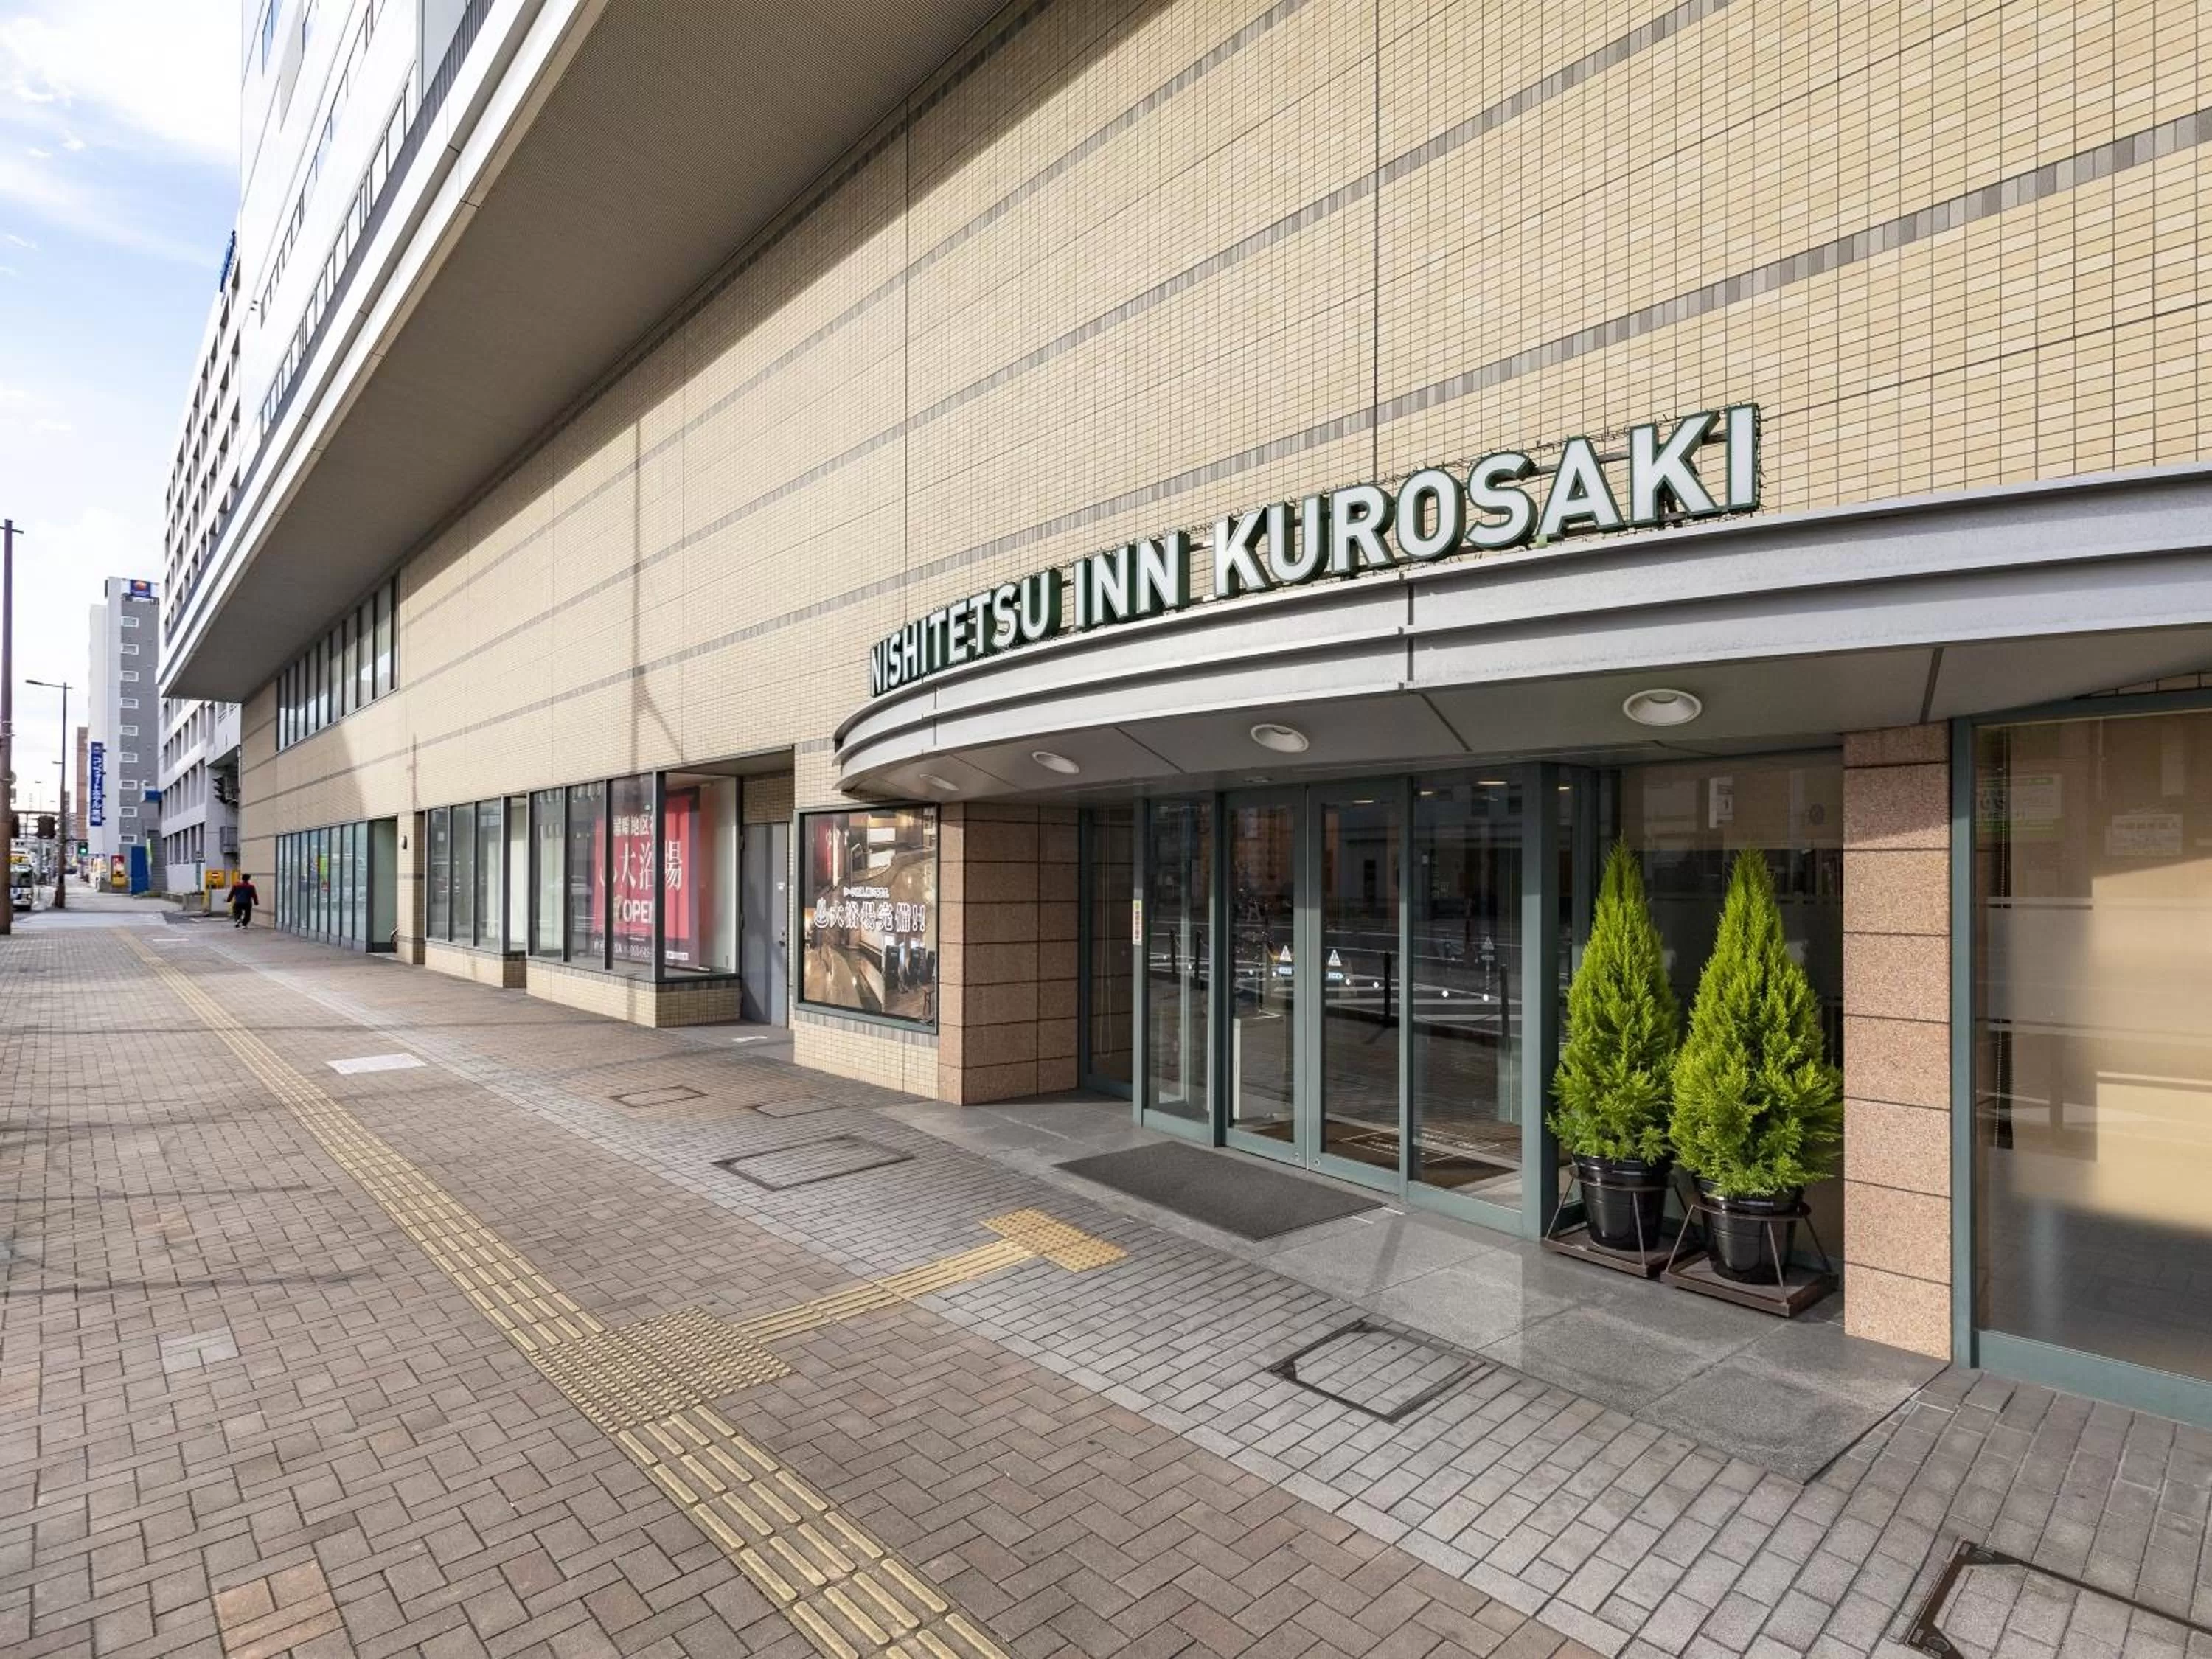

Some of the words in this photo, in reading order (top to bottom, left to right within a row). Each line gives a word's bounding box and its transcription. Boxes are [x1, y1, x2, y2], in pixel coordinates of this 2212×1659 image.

[870, 568, 1060, 697] NISHITETSU
[1074, 529, 1189, 631] INN
[1214, 403, 1760, 597] KUROSAKI
